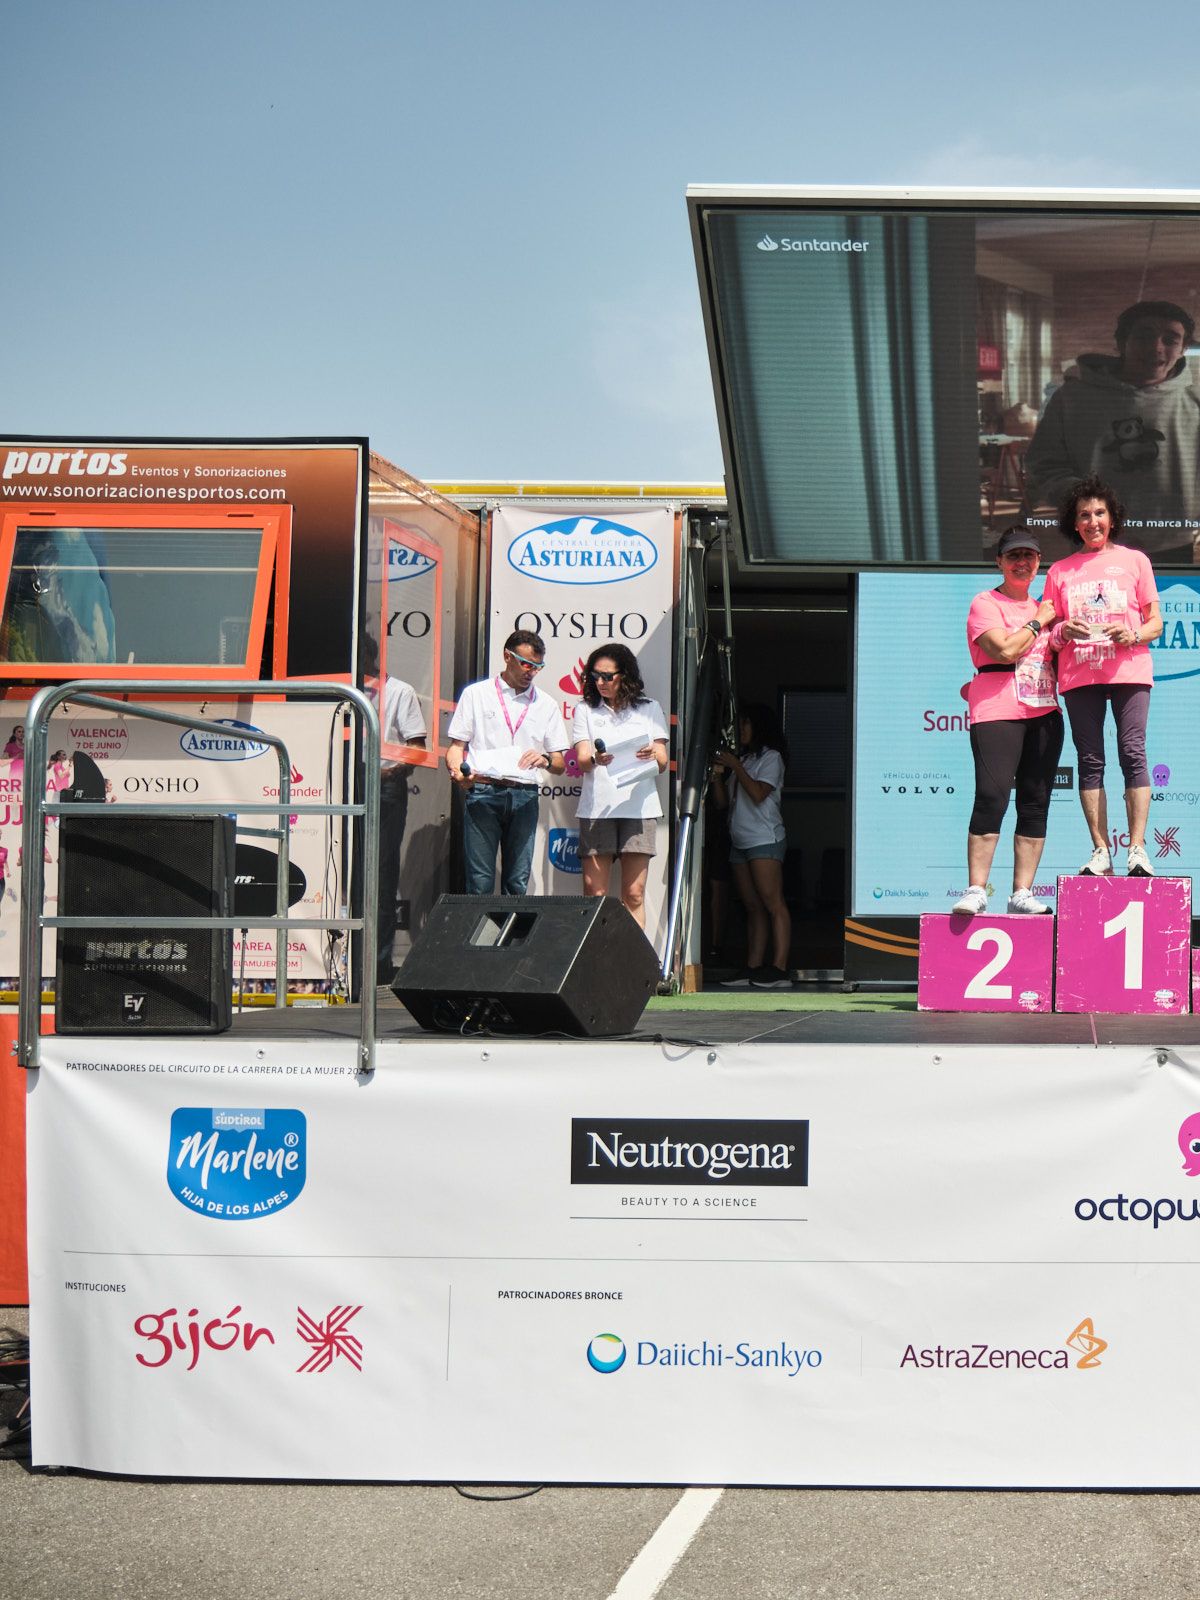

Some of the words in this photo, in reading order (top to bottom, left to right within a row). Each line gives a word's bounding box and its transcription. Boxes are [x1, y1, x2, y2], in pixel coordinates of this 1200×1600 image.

[780, 238, 870, 252] Santander
[2, 449, 128, 479] portos
[131, 465, 179, 477] Eventos
[183, 467, 190, 478] y
[194, 465, 287, 478] Sonorizaciones
[2, 484, 286, 501] www.sonorizacionesportos.com
[1146, 519, 1181, 528] marca
[518, 541, 646, 567] ASTURIANA
[514, 611, 648, 640] OYSHO
[70, 729, 128, 738] VALENCIA
[124, 777, 199, 793] OYSHO
[881, 786, 955, 794] VOLVO
[1165, 792, 1200, 805] energy
[1032, 886, 1056, 897] COSMO
[1104, 901, 1144, 989] 1
[964, 927, 1013, 999] 2
[66, 1063, 146, 1072] PATROCINADORES
[148, 1064, 166, 1073] DEL
[168, 1064, 210, 1073] CIRCUITO
[213, 1065, 225, 1073] DE
[227, 1066, 239, 1074] LA
[241, 1066, 283, 1074] CARRERA
[286, 1066, 298, 1074] DE
[300, 1067, 312, 1075] LA
[314, 1067, 345, 1075] MUJER
[180, 1186, 204, 1208] HIJA
[207, 1201, 223, 1213] DE
[226, 1204, 249, 1215] LOS
[253, 1190, 289, 1213] ALPES
[621, 1197, 667, 1206] BEAUTY
[673, 1198, 688, 1206] TO
[693, 1198, 700, 1206] A
[705, 1198, 757, 1207] SCIENCE
[65, 1281, 126, 1292] INSTITUCIONES
[498, 1290, 582, 1300] PATROCINADORES
[585, 1291, 623, 1300] BRONCE
[134, 1305, 275, 1371] gijón
[637, 1341, 823, 1377] Daiichi-Sankyo
[900, 1344, 1069, 1369] AstraZeneca
